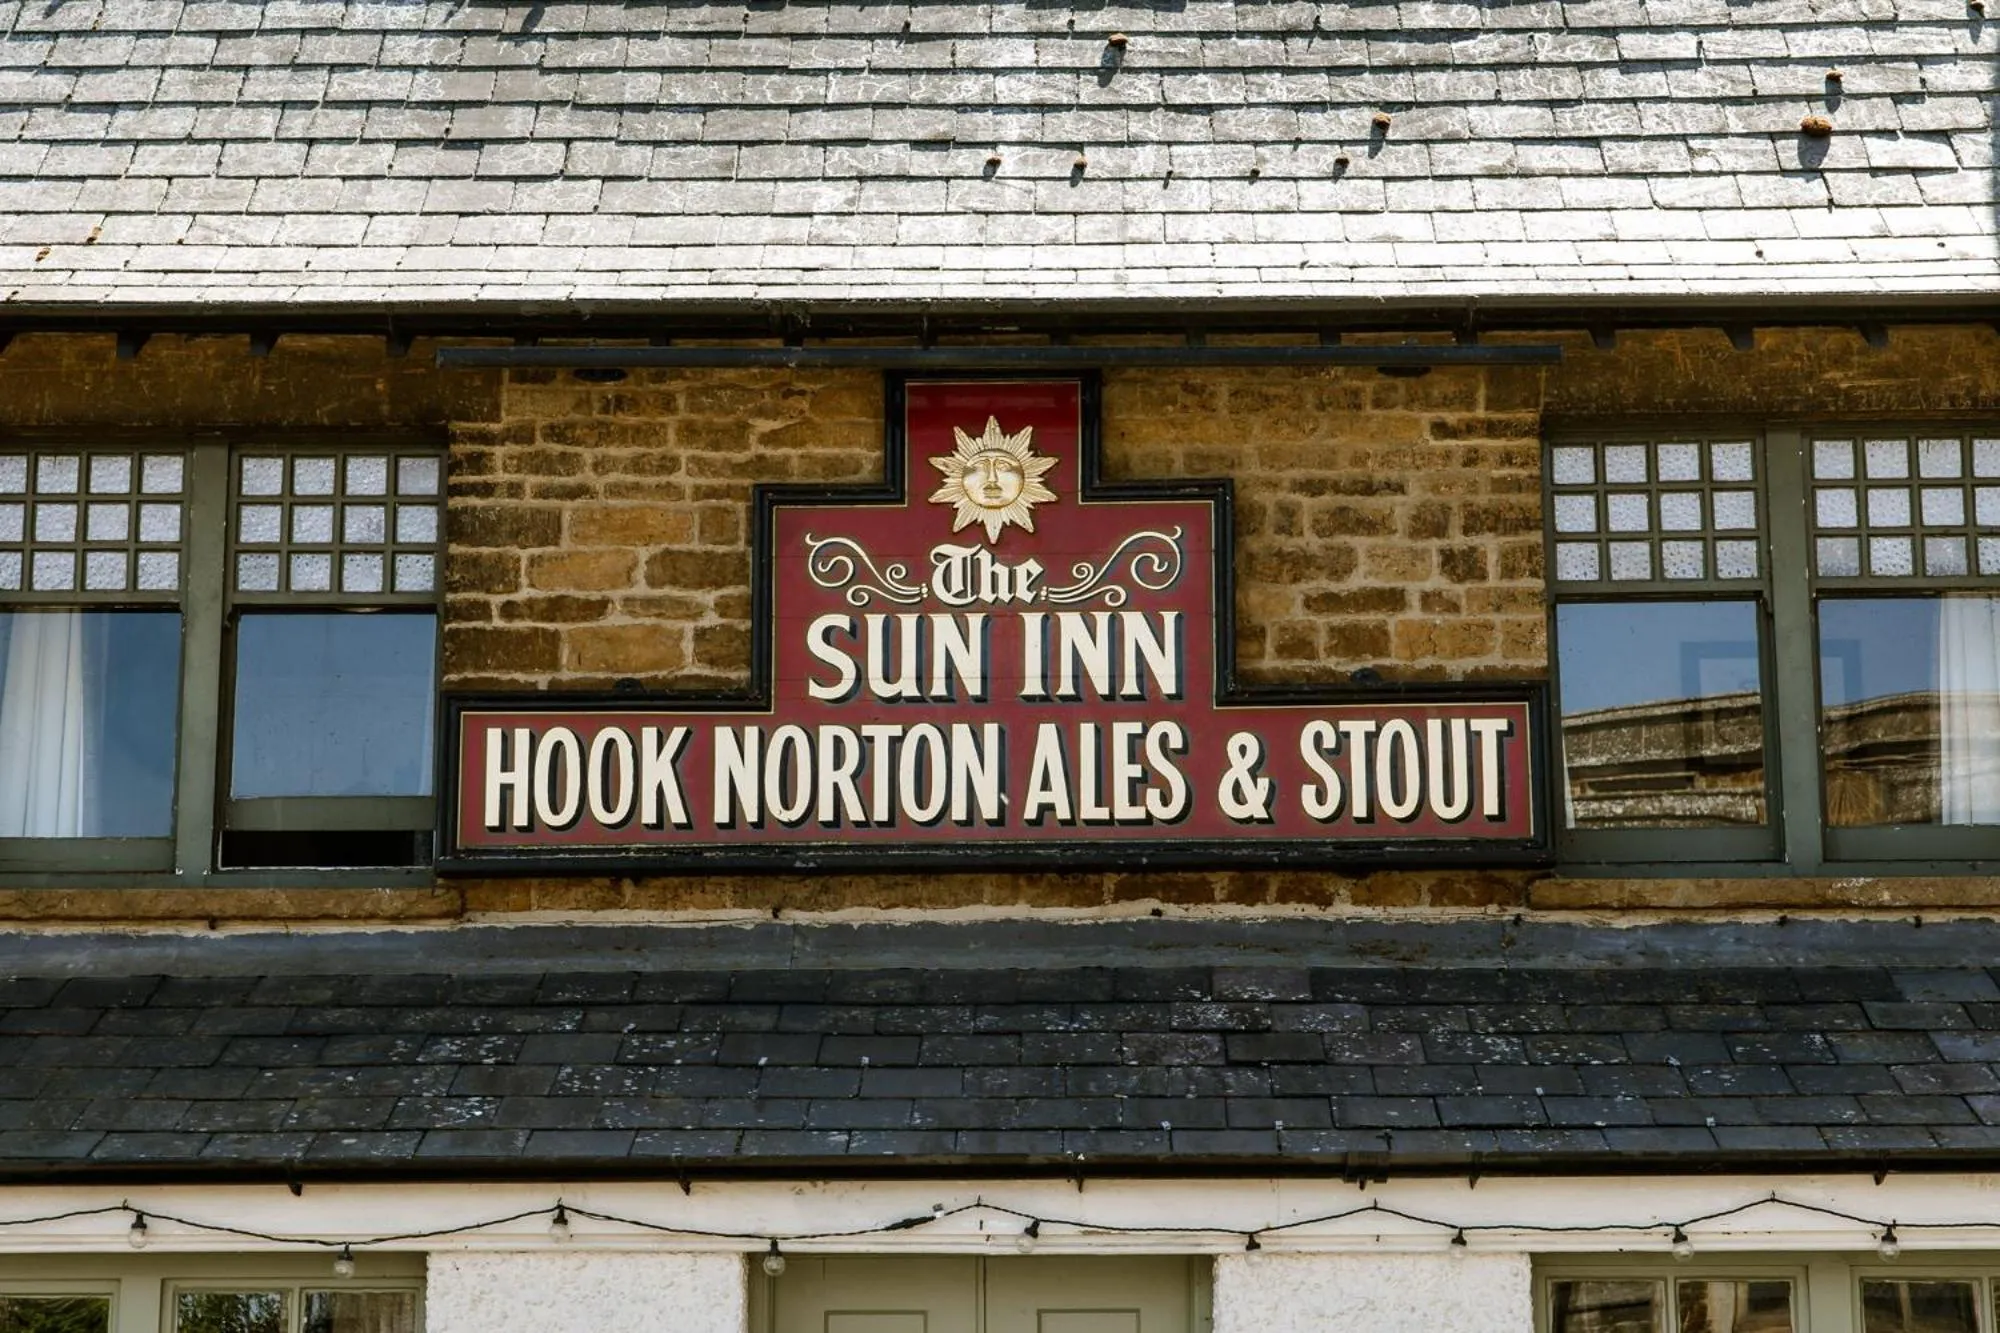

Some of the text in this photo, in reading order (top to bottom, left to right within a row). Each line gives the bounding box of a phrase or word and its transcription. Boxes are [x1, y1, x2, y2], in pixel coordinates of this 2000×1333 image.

[929, 543, 1044, 606] The
[806, 610, 1181, 701] SUN INN
[484, 717, 1510, 831] HOOK NORTON ALES & STOUT
